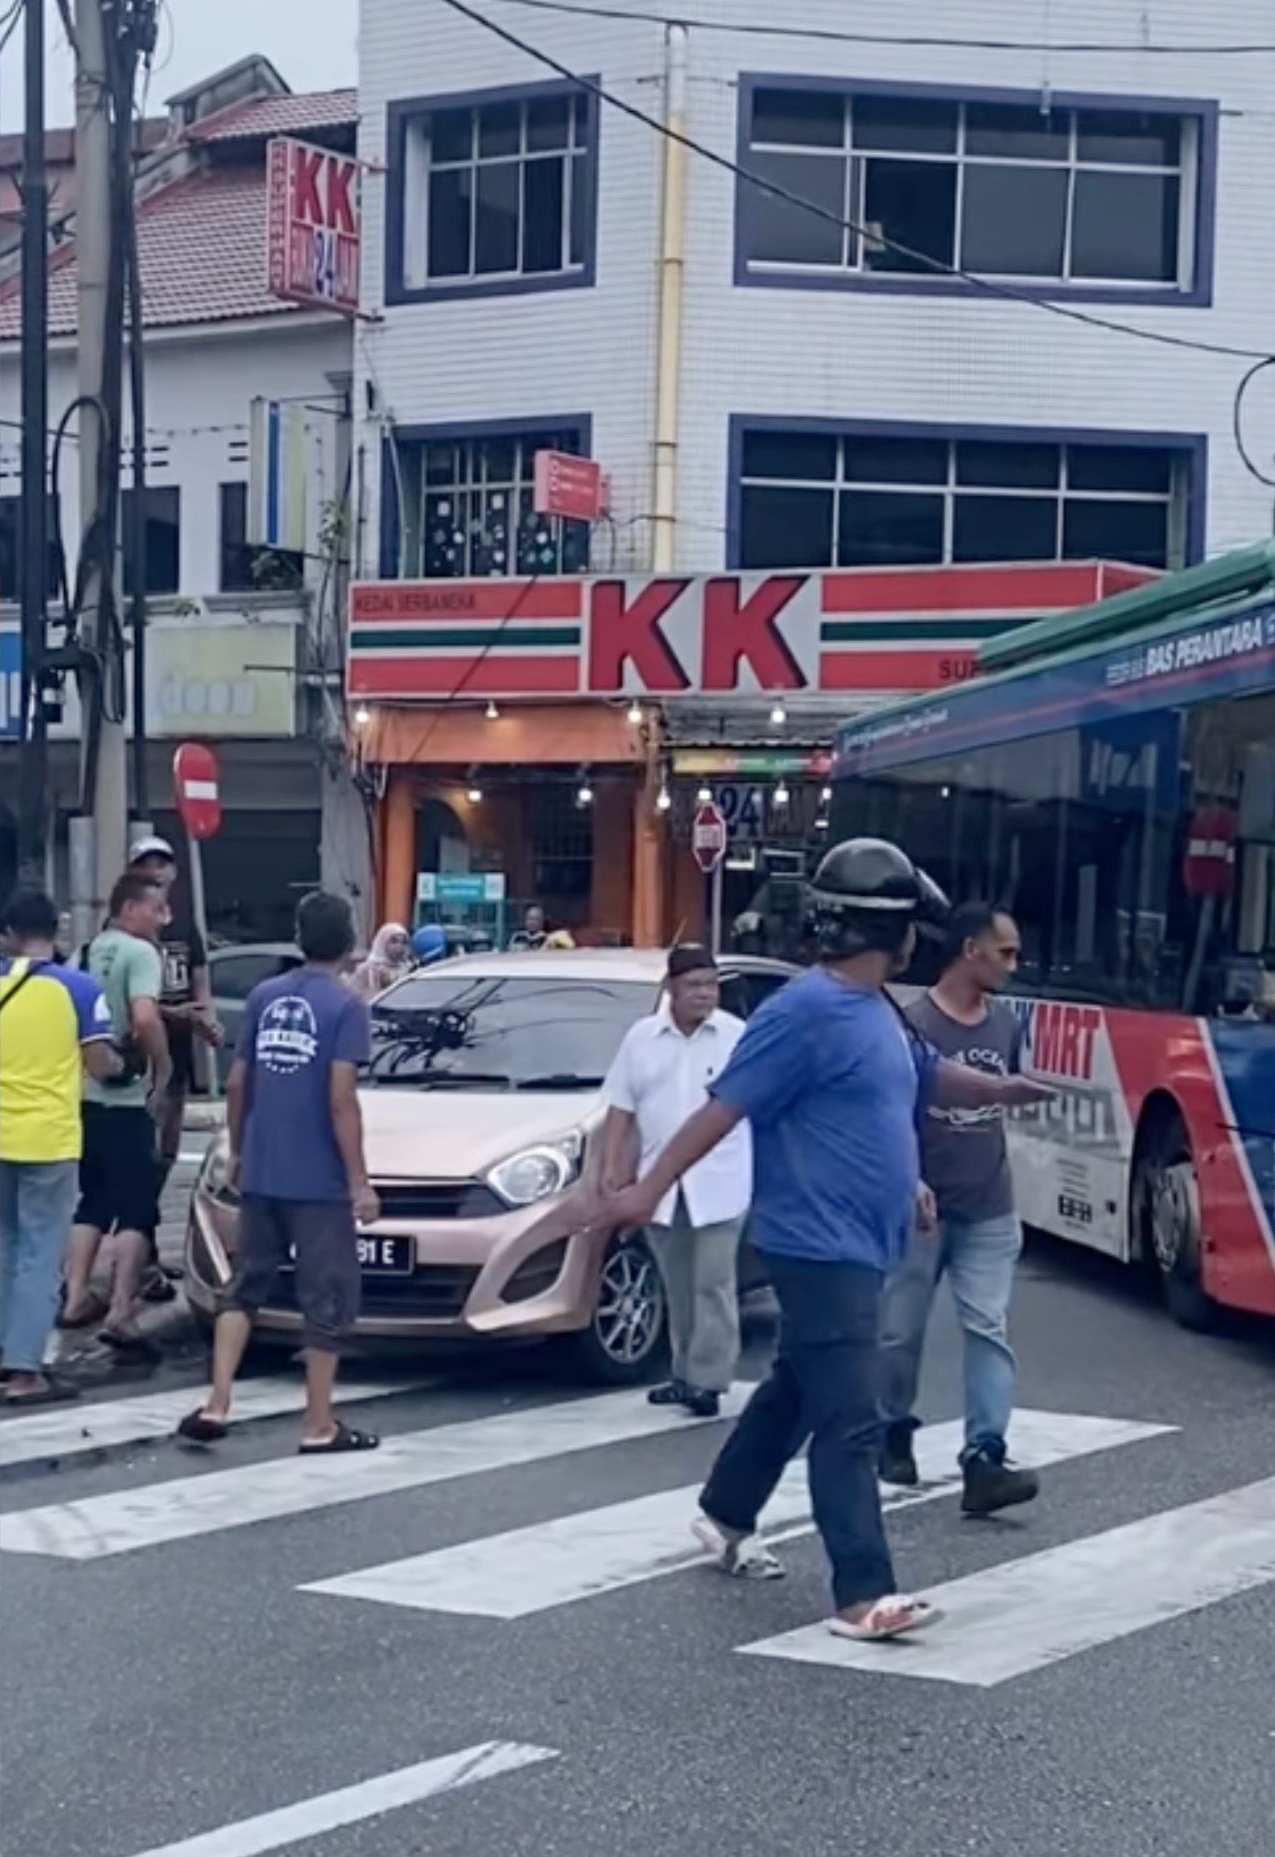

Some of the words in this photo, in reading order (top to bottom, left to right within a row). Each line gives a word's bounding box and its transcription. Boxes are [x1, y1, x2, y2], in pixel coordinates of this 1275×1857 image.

[296, 147, 355, 233] KK
[589, 574, 811, 691] KK
[1034, 1003, 1101, 1080] MRT
[381, 1240, 395, 1265] E
